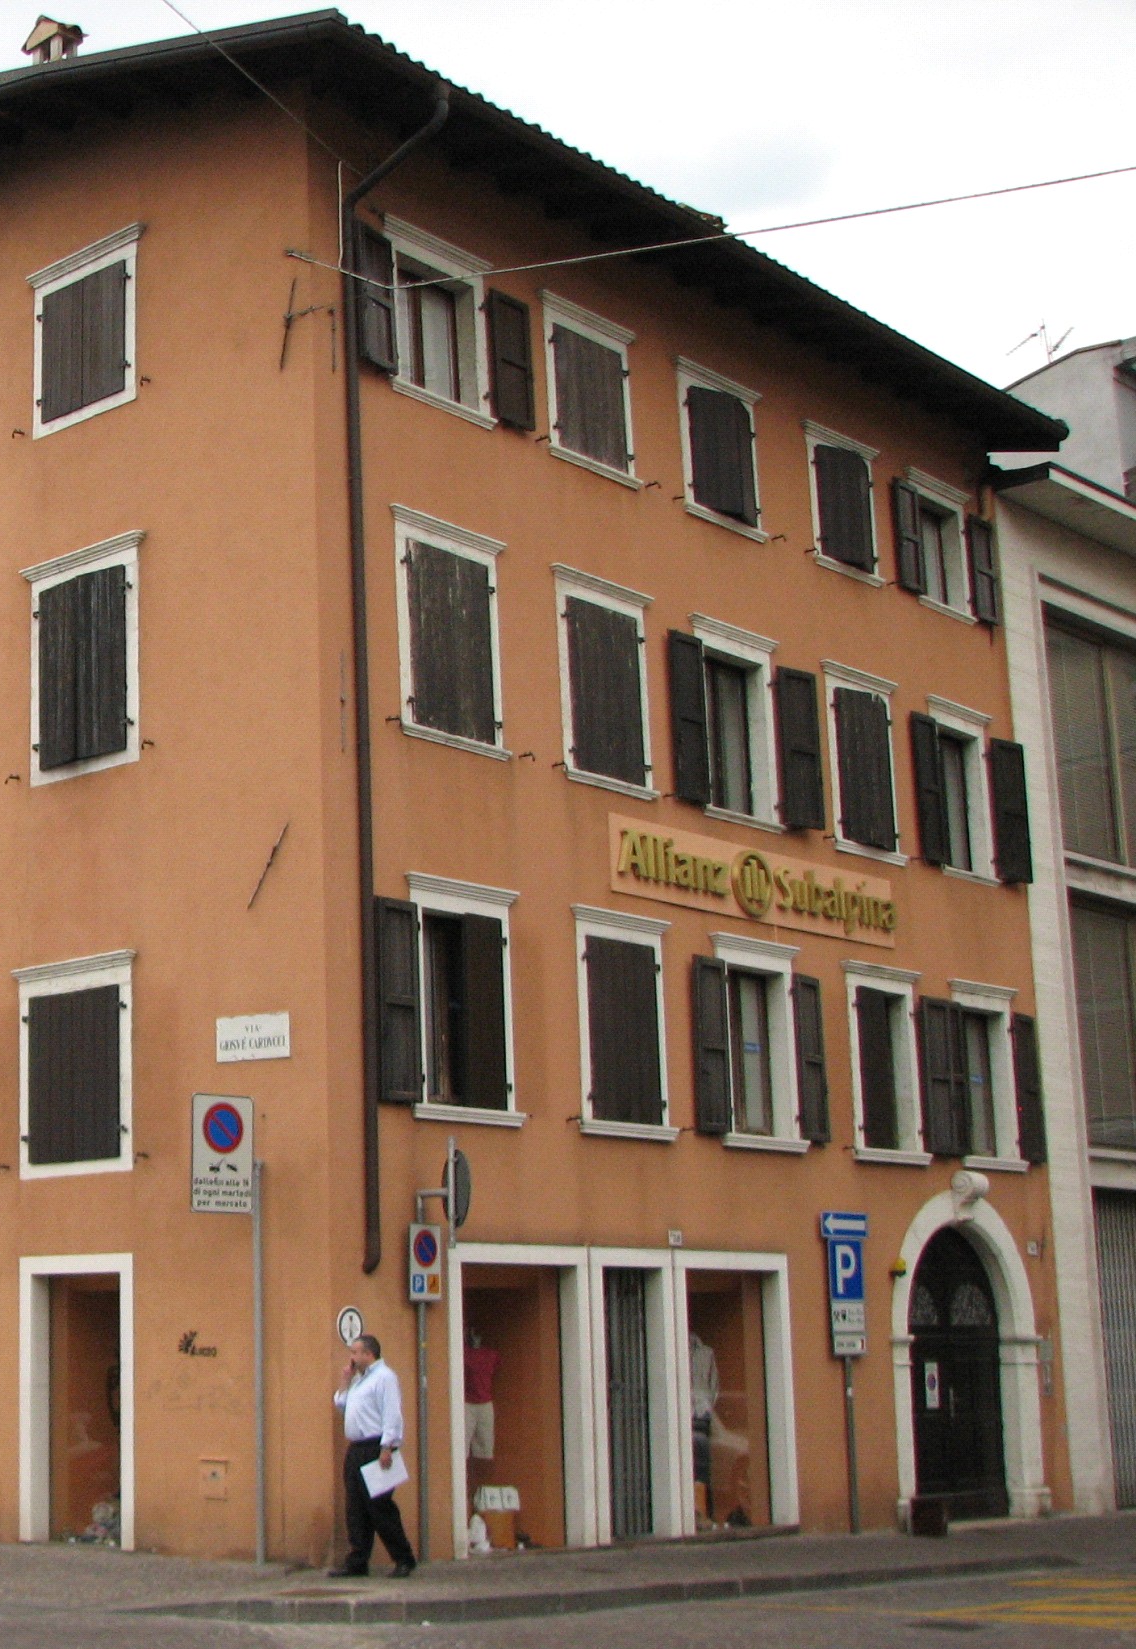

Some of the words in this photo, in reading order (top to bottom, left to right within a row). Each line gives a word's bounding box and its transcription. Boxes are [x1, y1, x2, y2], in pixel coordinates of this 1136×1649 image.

[617, 829, 729, 897] Allianz
[773, 864, 897, 935] Subalpina
[244, 1024, 260, 1033] VIA
[835, 1245, 856, 1294] P
